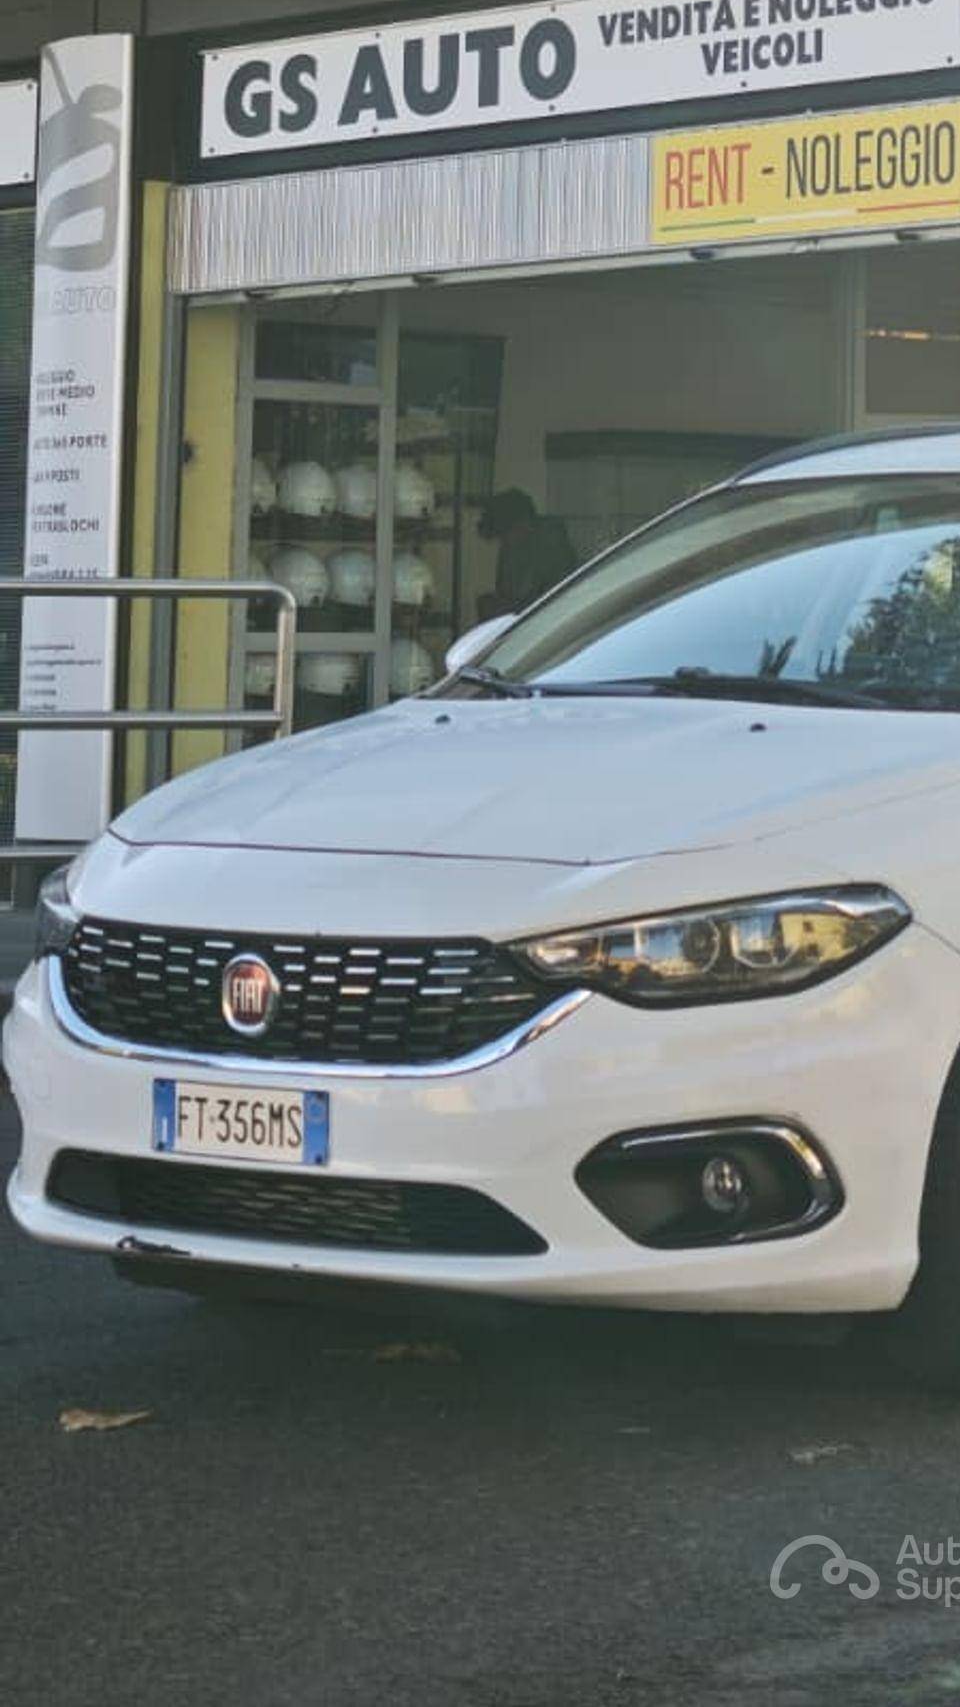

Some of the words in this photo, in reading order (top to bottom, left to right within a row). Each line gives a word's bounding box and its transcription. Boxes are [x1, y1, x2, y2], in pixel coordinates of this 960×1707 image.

[223, 53, 318, 139] GS
[337, 17, 577, 126] AUTO
[701, 28, 824, 78] VEICOLI
[663, 142, 751, 212] RENT
[785, 119, 957, 199] NOLEGGIO
[232, 976, 264, 1013] FIAT
